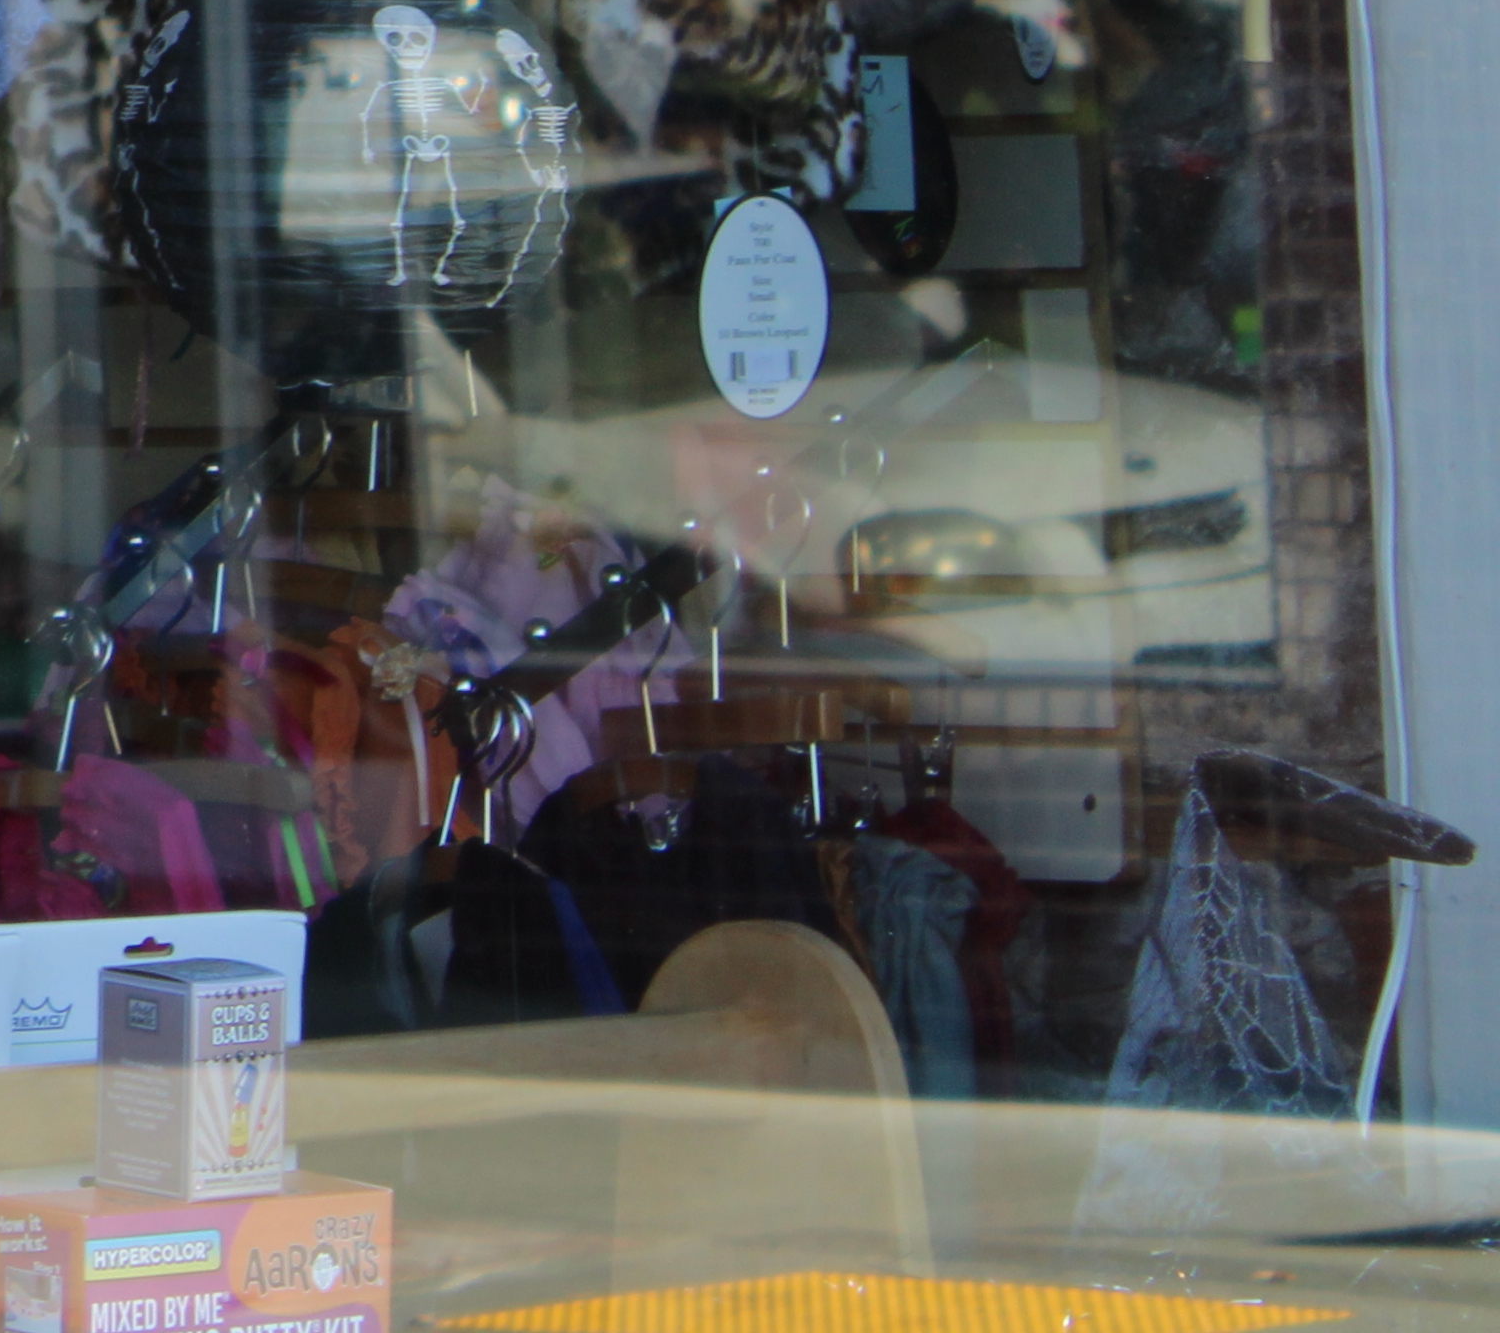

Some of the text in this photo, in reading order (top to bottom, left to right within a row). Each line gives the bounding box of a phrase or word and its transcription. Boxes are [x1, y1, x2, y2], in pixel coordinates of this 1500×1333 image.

[211, 1002, 271, 1025] CUPS &
[212, 1022, 270, 1046] BALLS
[28, 1213, 42, 1231] it
[90, 1298, 158, 1333] MIXED
[164, 1295, 191, 1328] BY
